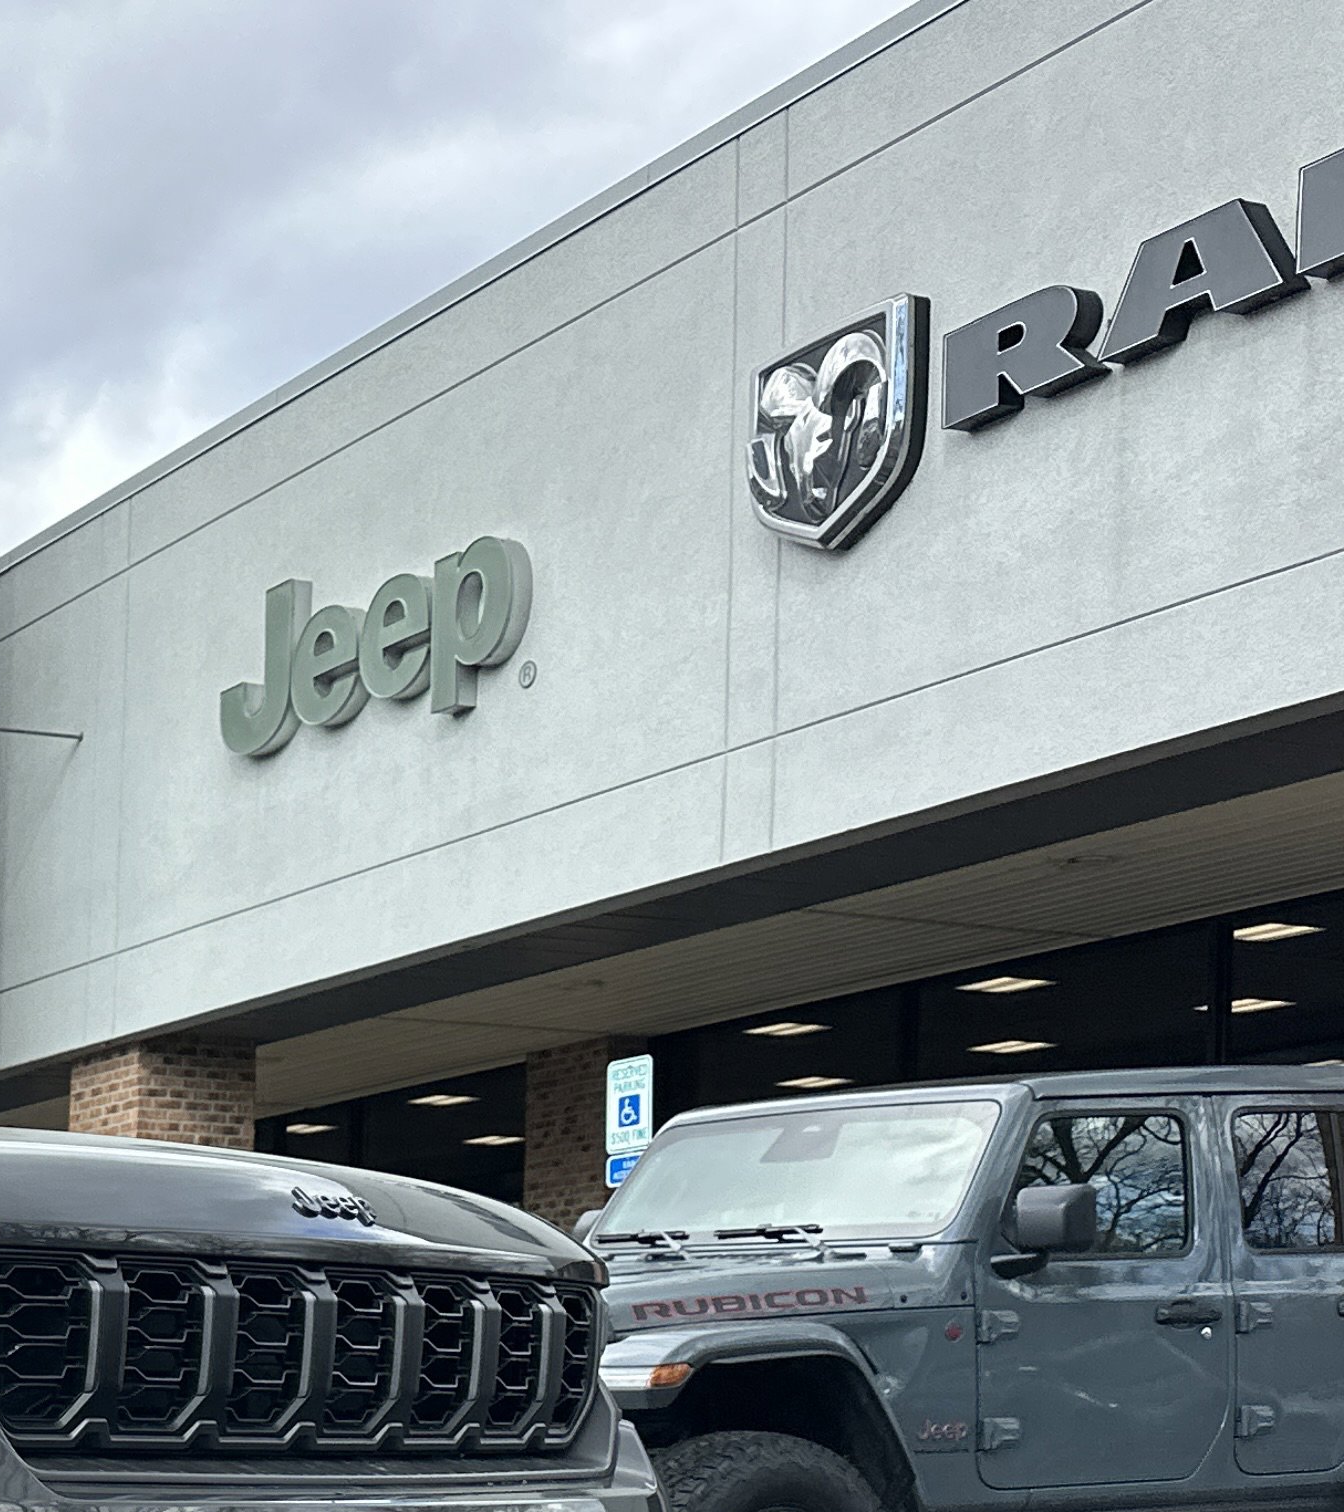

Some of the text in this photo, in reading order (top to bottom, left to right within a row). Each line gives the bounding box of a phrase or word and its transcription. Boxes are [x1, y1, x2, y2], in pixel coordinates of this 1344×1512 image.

[219, 535, 534, 757] Jeep
[291, 1186, 378, 1228] Jeep
[630, 1285, 870, 1322] RUBICON
[916, 1418, 969, 1442] Jeep
